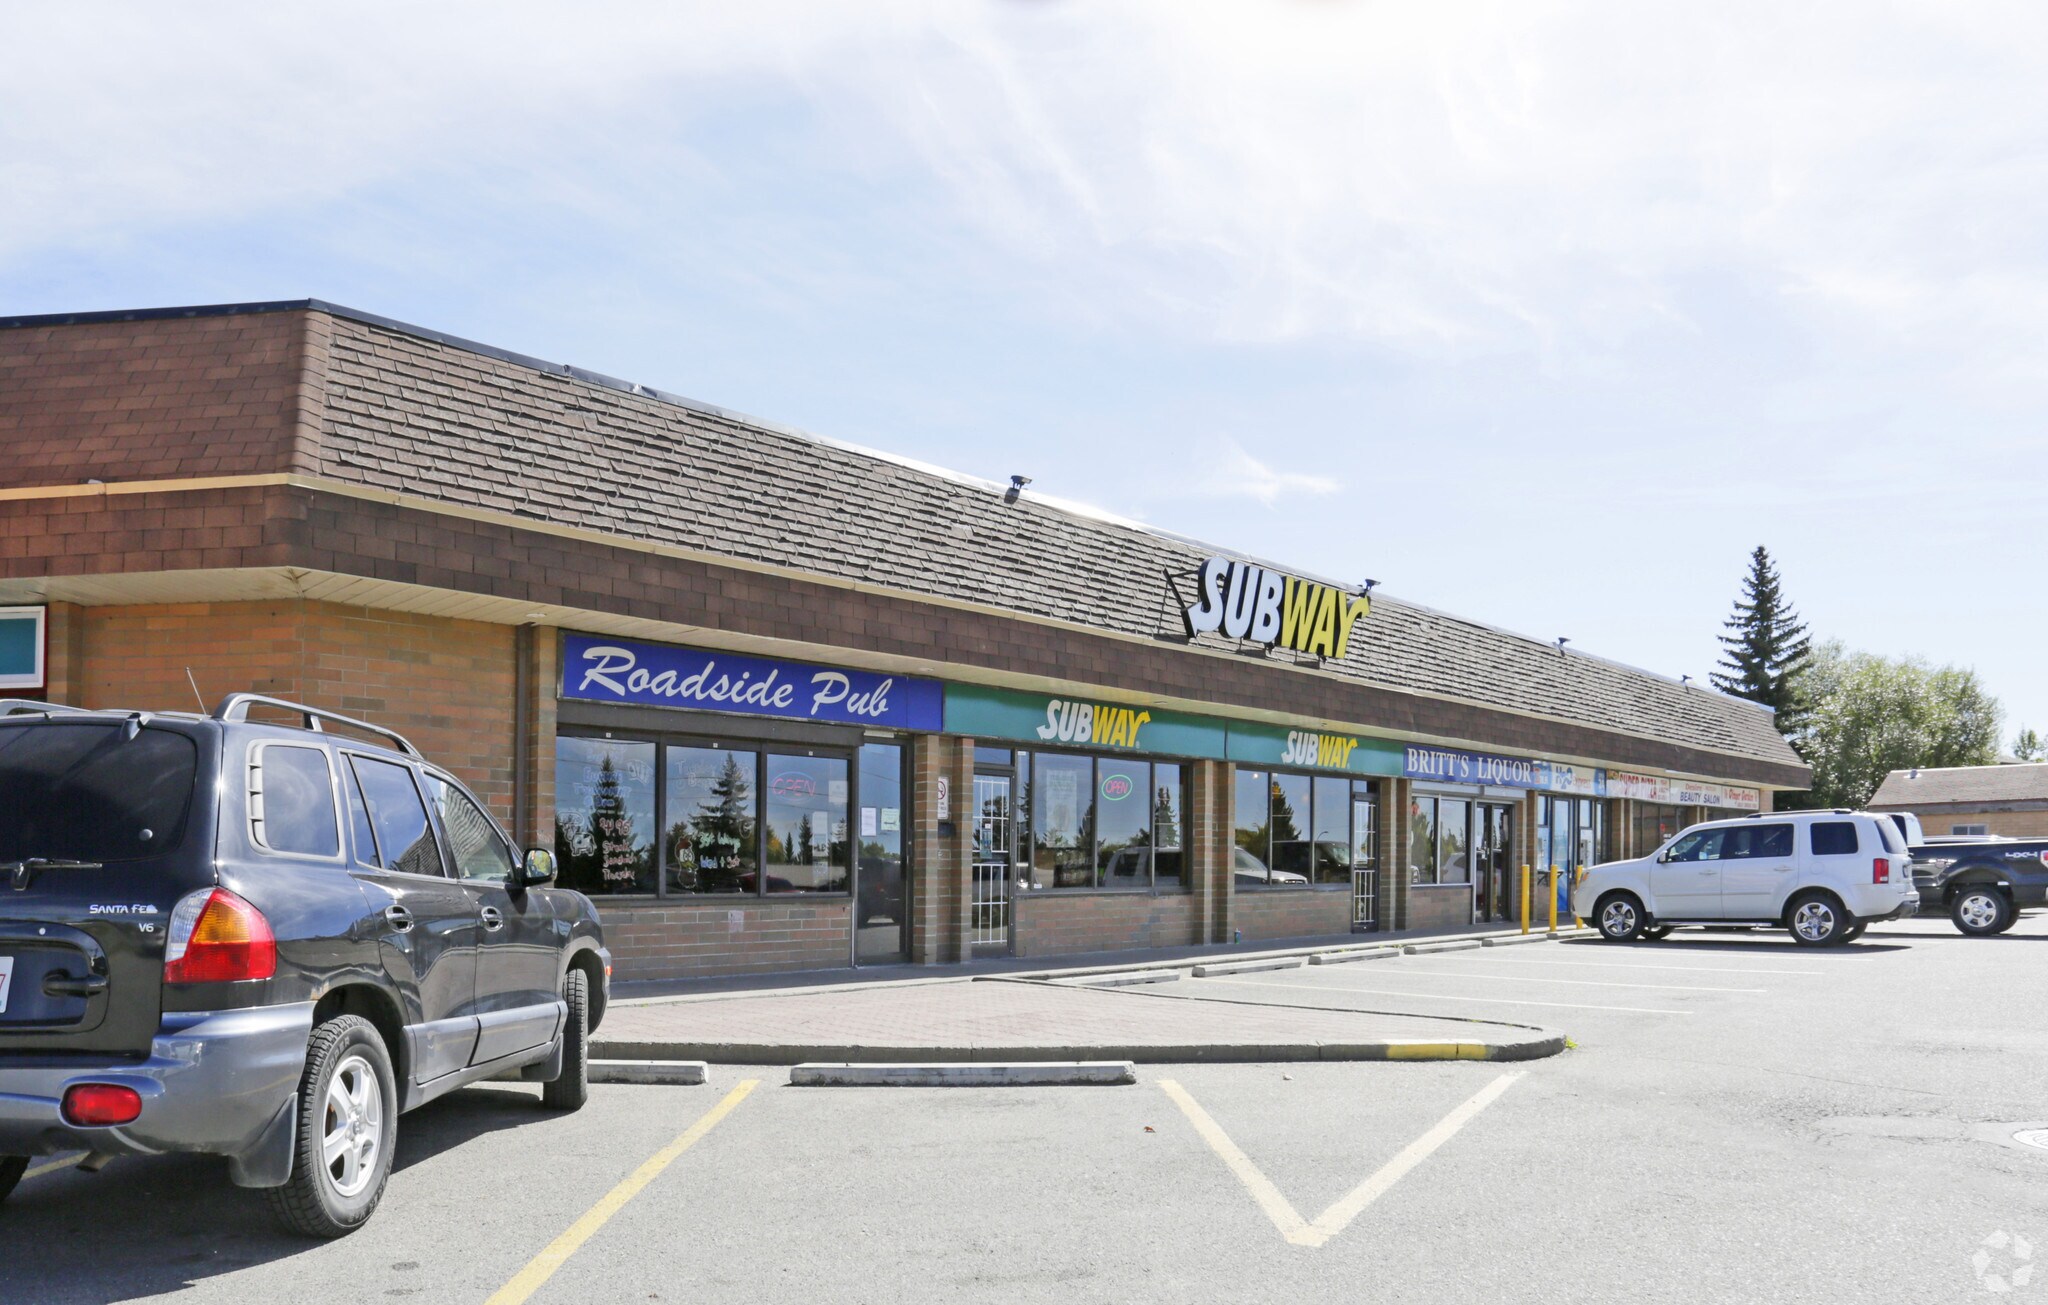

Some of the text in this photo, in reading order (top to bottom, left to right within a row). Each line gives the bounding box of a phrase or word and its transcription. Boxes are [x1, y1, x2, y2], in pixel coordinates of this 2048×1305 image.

[1188, 556, 1370, 659] SUBWAY
[579, 646, 893, 717] Roadside Pub
[1036, 699, 1151, 748] SUBWAY
[1281, 730, 1358, 768] SUBWAY
[1407, 748, 1469, 778] BRITT'S
[1477, 757, 1531, 784] LIQUOR
[773, 778, 816, 796] OPEN
[1105, 780, 1129, 794] OPEN
[1680, 792, 1720, 805] BEAUTY SALON
[89, 904, 129, 914] SANTA
[139, 922, 154, 933] V6
